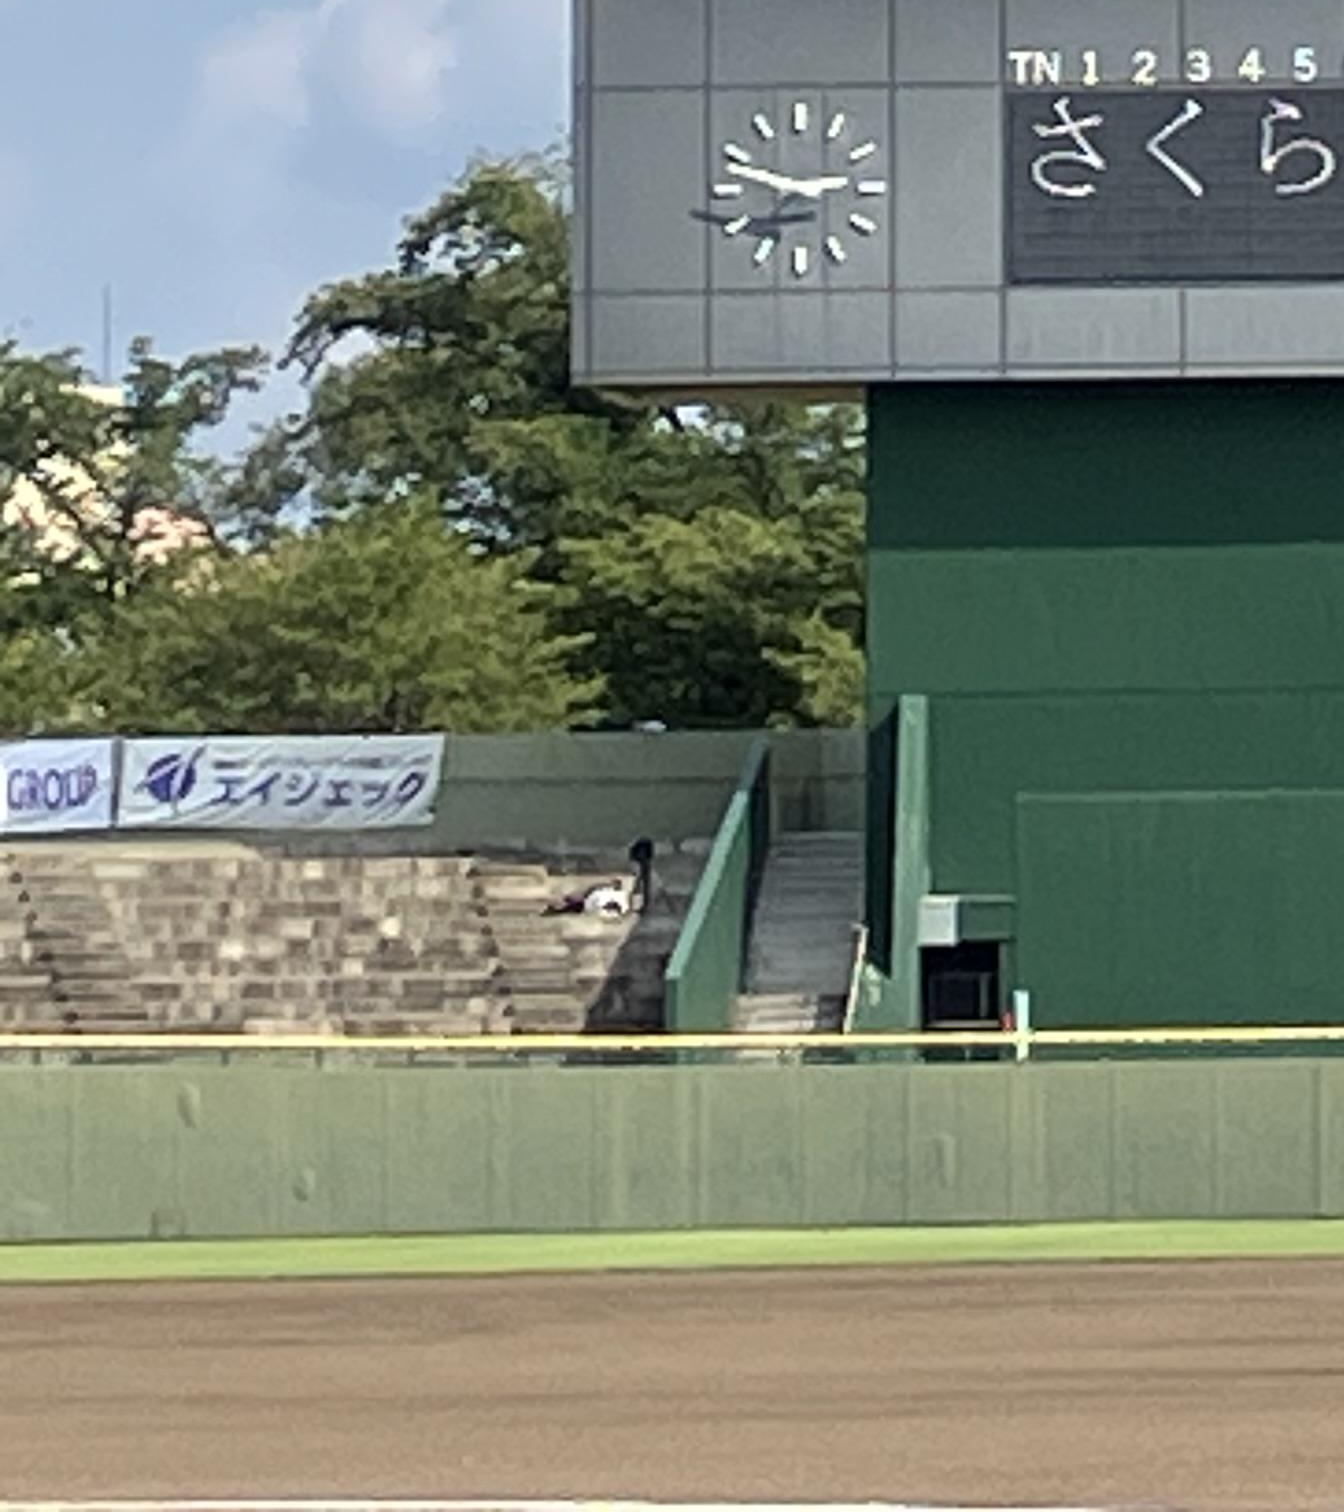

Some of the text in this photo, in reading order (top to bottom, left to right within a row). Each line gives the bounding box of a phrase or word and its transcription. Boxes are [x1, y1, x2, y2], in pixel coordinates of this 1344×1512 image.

[1009, 51, 1061, 85] TN
[1082, 51, 1100, 86] 1
[1132, 51, 1157, 84] 2
[1186, 50, 1212, 83] 3
[1237, 49, 1265, 83] 4
[1293, 47, 1318, 82] 5
[7, 765, 98, 810] GROUP
